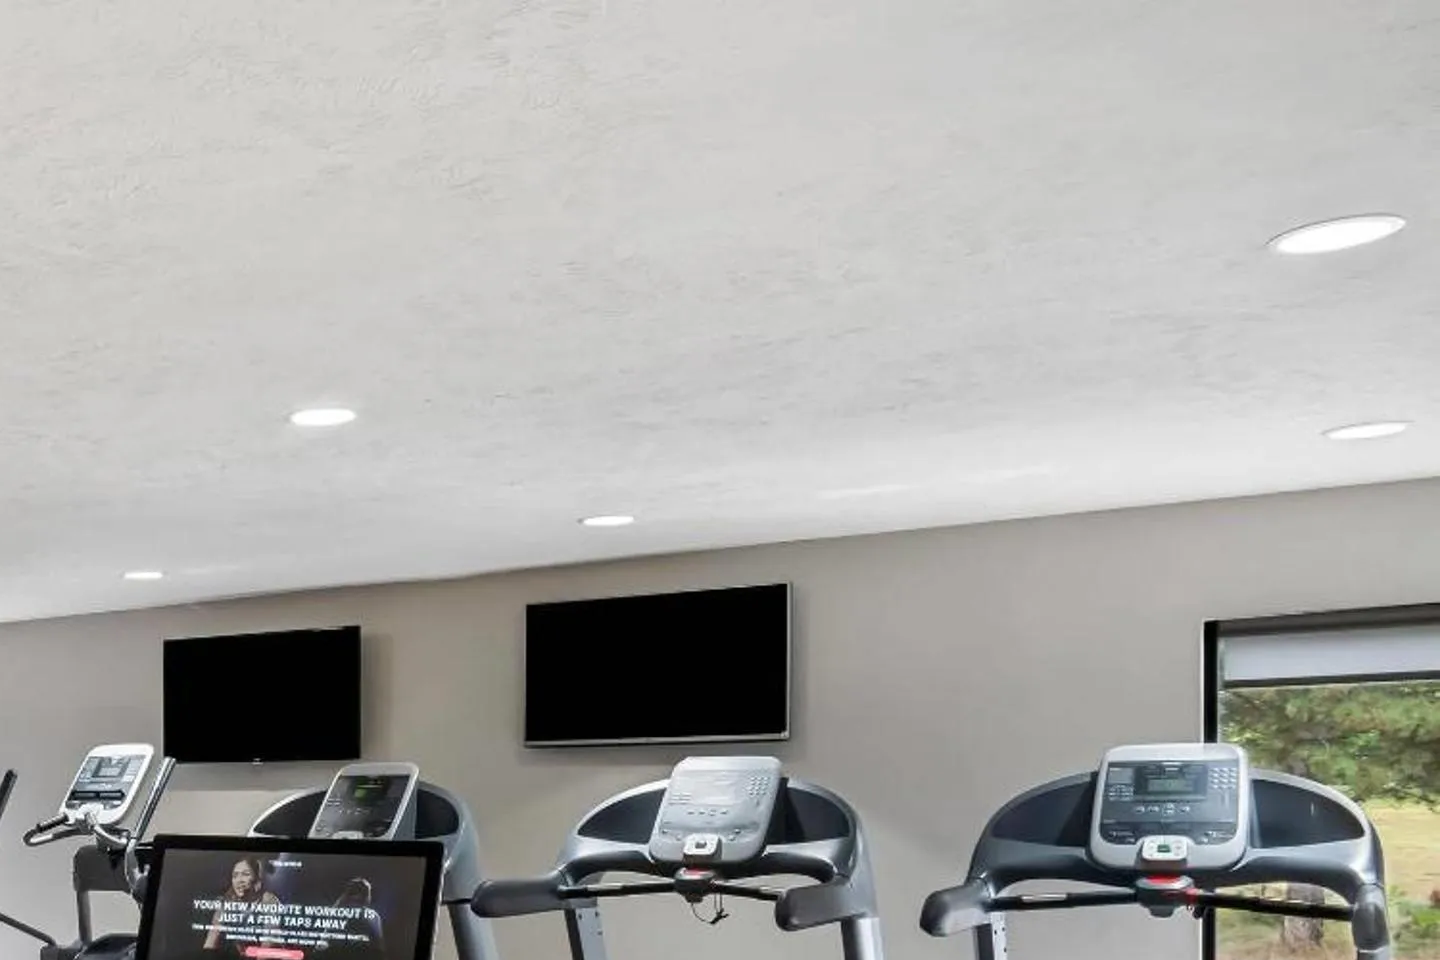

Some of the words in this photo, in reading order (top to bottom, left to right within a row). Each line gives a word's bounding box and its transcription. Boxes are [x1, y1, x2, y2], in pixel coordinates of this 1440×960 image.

[193, 900, 221, 910] YOUR
[224, 902, 249, 911] NEW
[251, 902, 301, 914] FAVORITE
[304, 905, 361, 918] WORKOUT
[364, 907, 375, 920] IS
[218, 913, 244, 922] JUST
[247, 914, 255, 924] A
[257, 915, 281, 925] FEW
[284, 916, 312, 928] TAPS
[314, 919, 347, 929] AWAY
